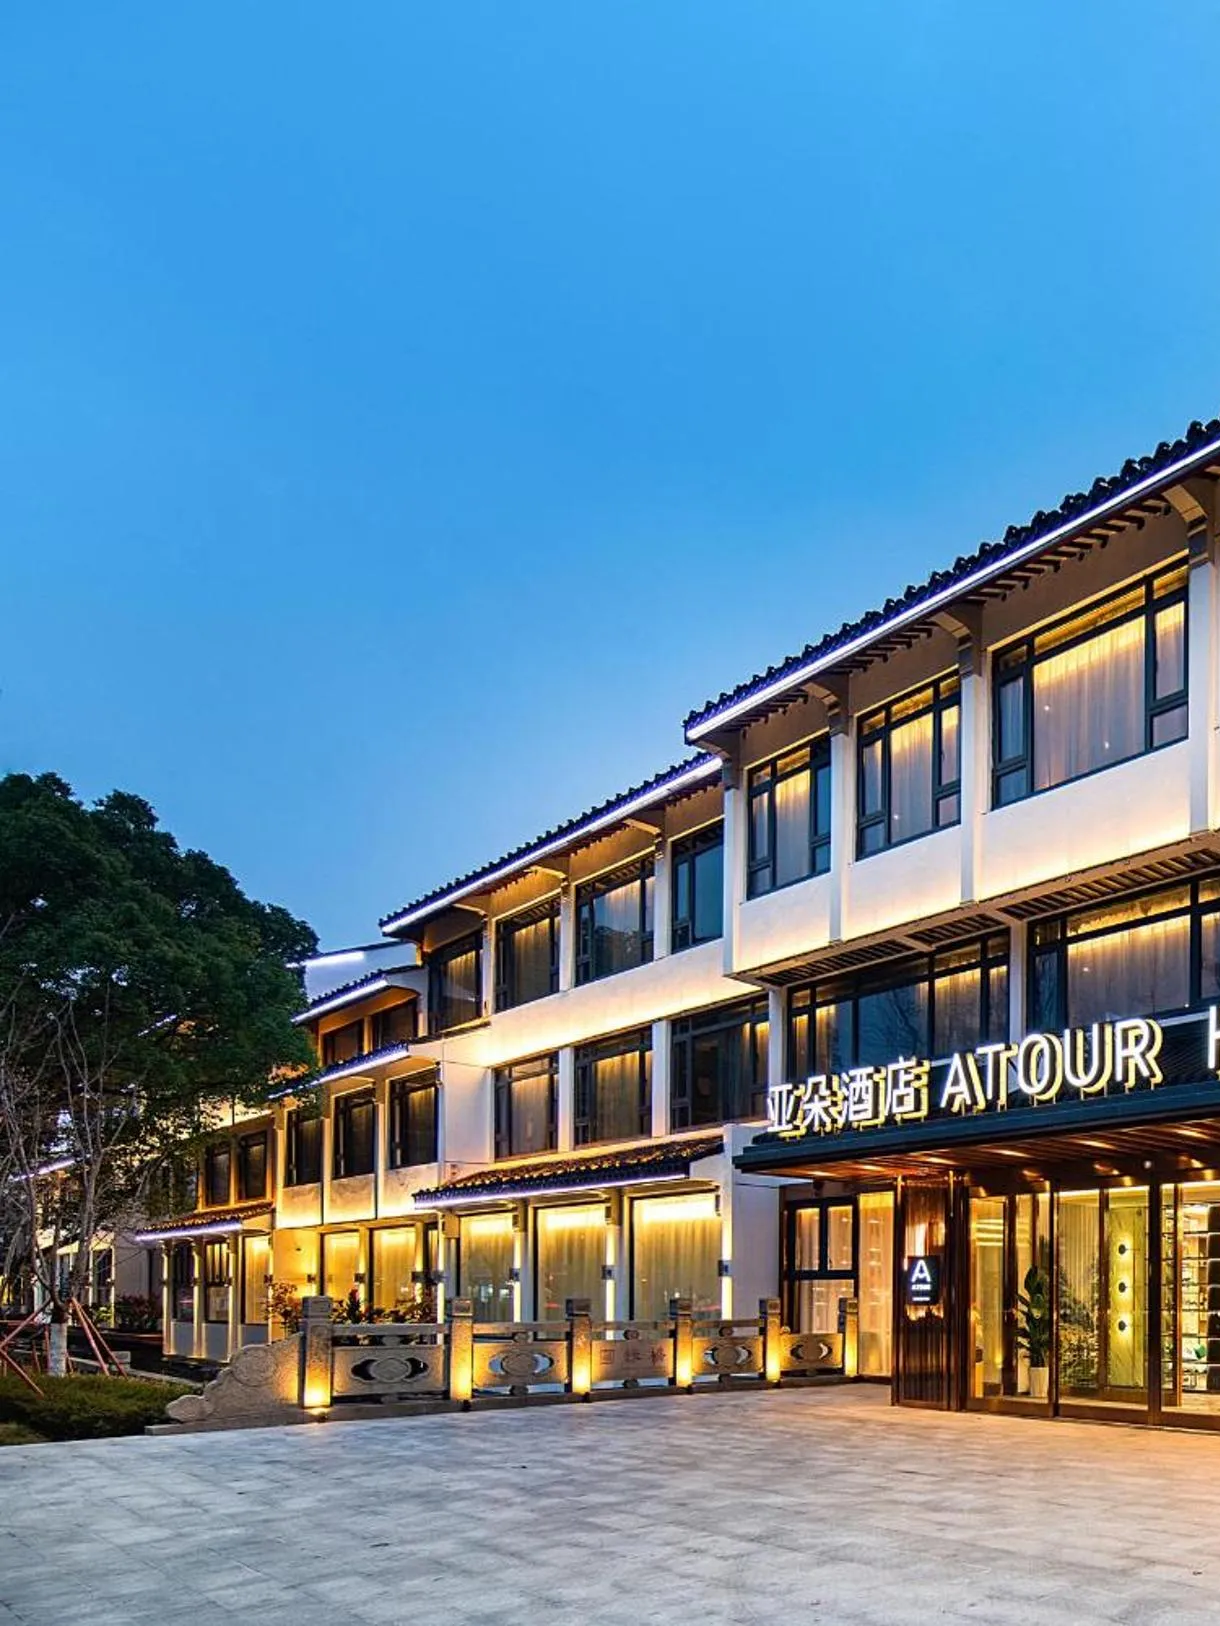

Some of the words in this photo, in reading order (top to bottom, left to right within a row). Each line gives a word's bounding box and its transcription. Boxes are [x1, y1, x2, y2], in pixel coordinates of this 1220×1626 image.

[767, 1057, 926, 1133] 亚朵酒店
[940, 1017, 1158, 1108] ATOUR
